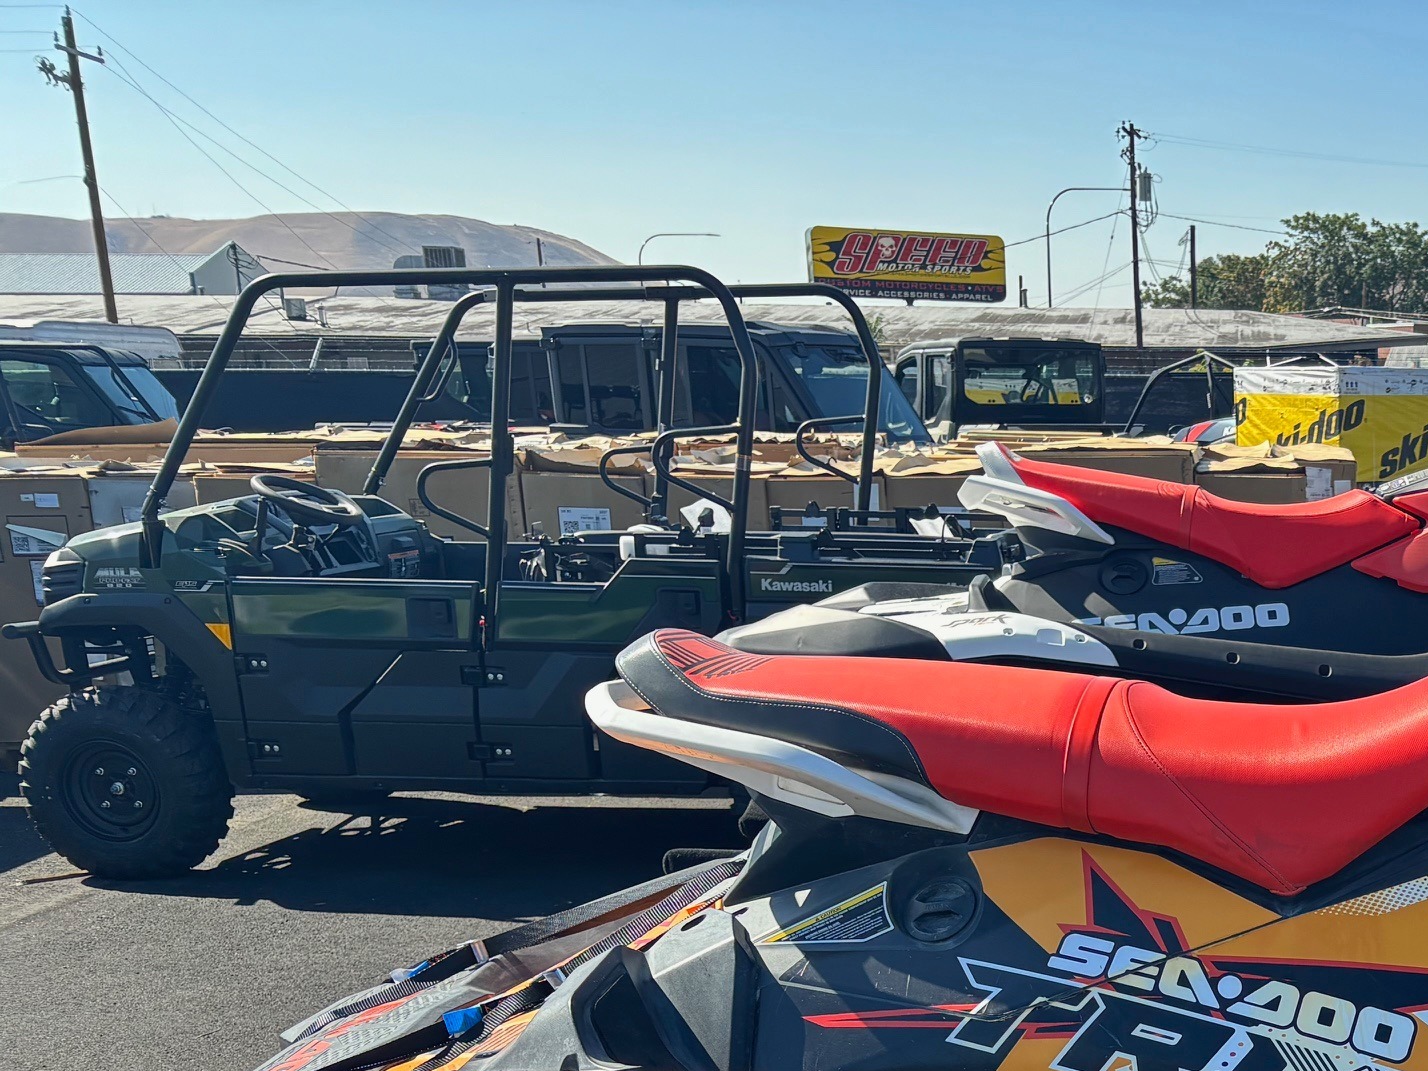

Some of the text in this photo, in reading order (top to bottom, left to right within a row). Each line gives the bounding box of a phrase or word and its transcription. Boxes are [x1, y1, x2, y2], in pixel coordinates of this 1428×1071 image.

[833, 232, 989, 275] SPEED
[876, 262, 920, 273] MOTOR
[925, 265, 973, 275] SPORTS
[875, 280, 967, 291] MOTORCYCLES
[877, 290, 946, 299] ACCESSORIES
[951, 293, 994, 301] APPAREL
[760, 578, 833, 593] Kawasaki
